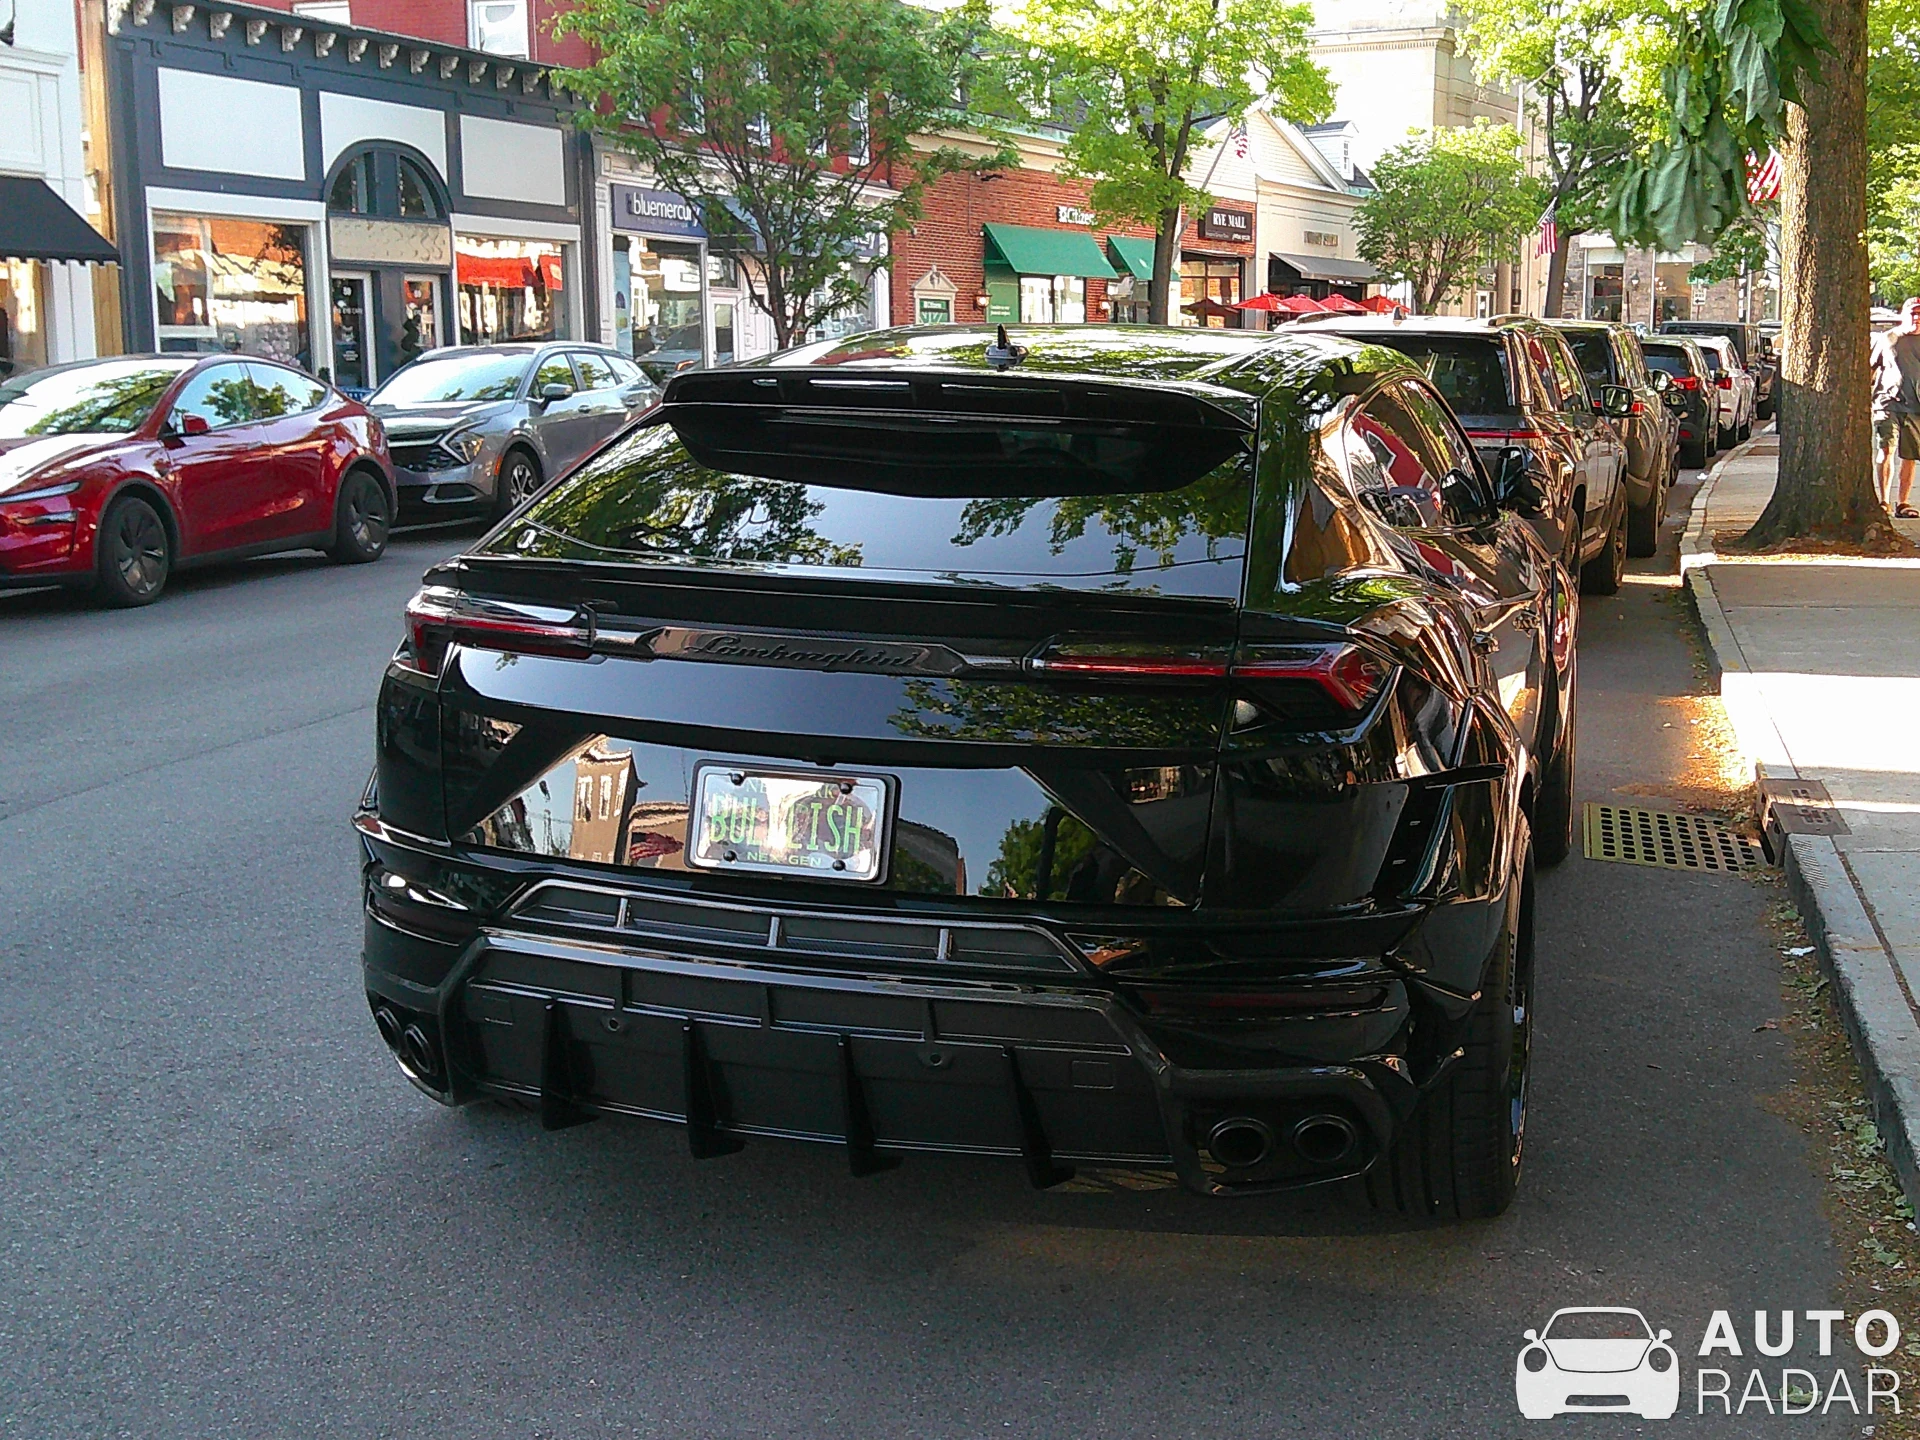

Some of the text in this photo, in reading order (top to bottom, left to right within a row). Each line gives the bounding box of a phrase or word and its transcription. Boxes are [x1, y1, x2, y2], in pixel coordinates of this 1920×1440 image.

[633, 192, 700, 227] bluemercury
[1212, 212, 1247, 229] RYE MALL
[684, 635, 920, 667] Lamborghini
[788, 855, 822, 868] GEN
